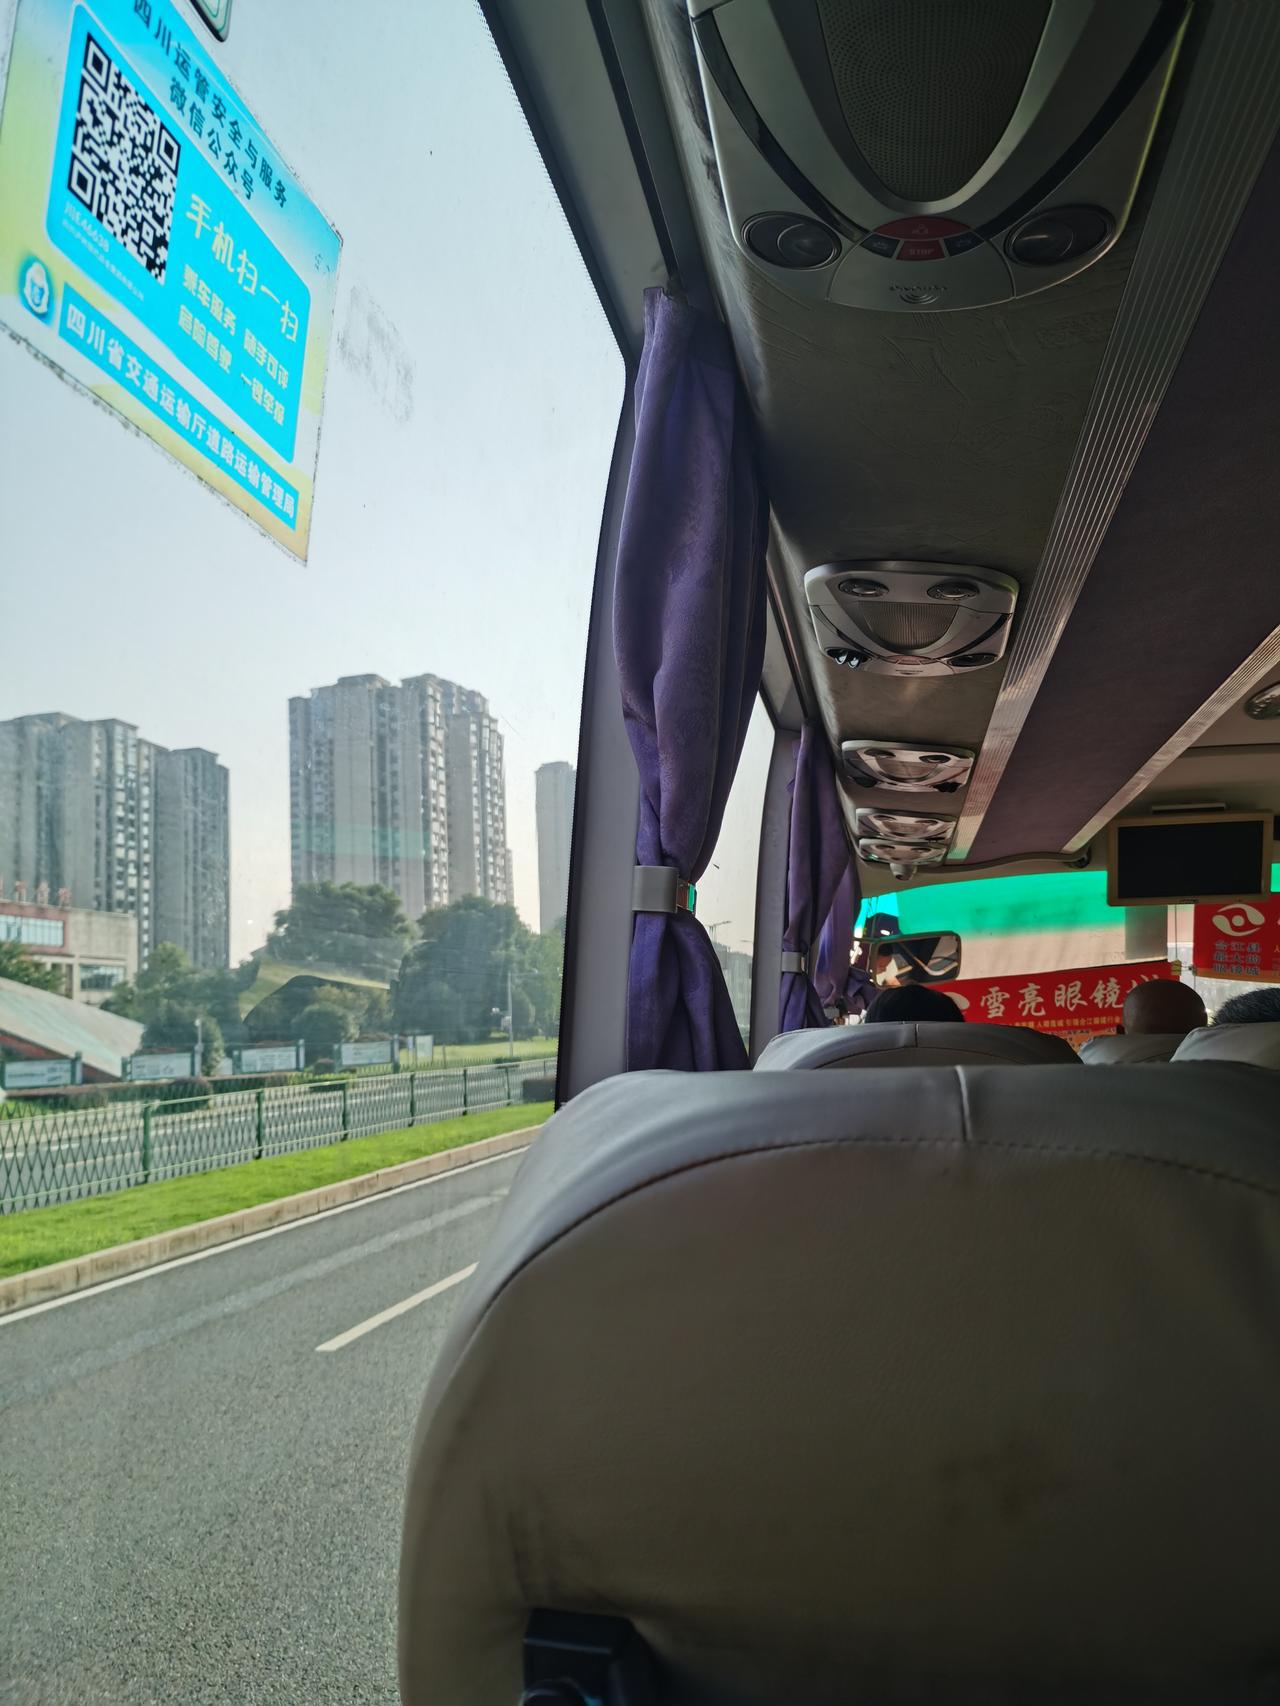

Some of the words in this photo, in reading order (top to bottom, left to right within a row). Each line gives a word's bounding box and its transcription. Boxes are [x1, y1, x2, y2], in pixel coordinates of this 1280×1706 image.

[134, 0, 287, 208] 四川运管安全与服务
[170, 77, 255, 200] 微信公众号
[187, 193, 298, 342] 手机扫一扫
[67, 304, 295, 518] 四川省交通运输厅道路运输管理局
[980, 974, 1161, 1019] 雪亮眼镜
